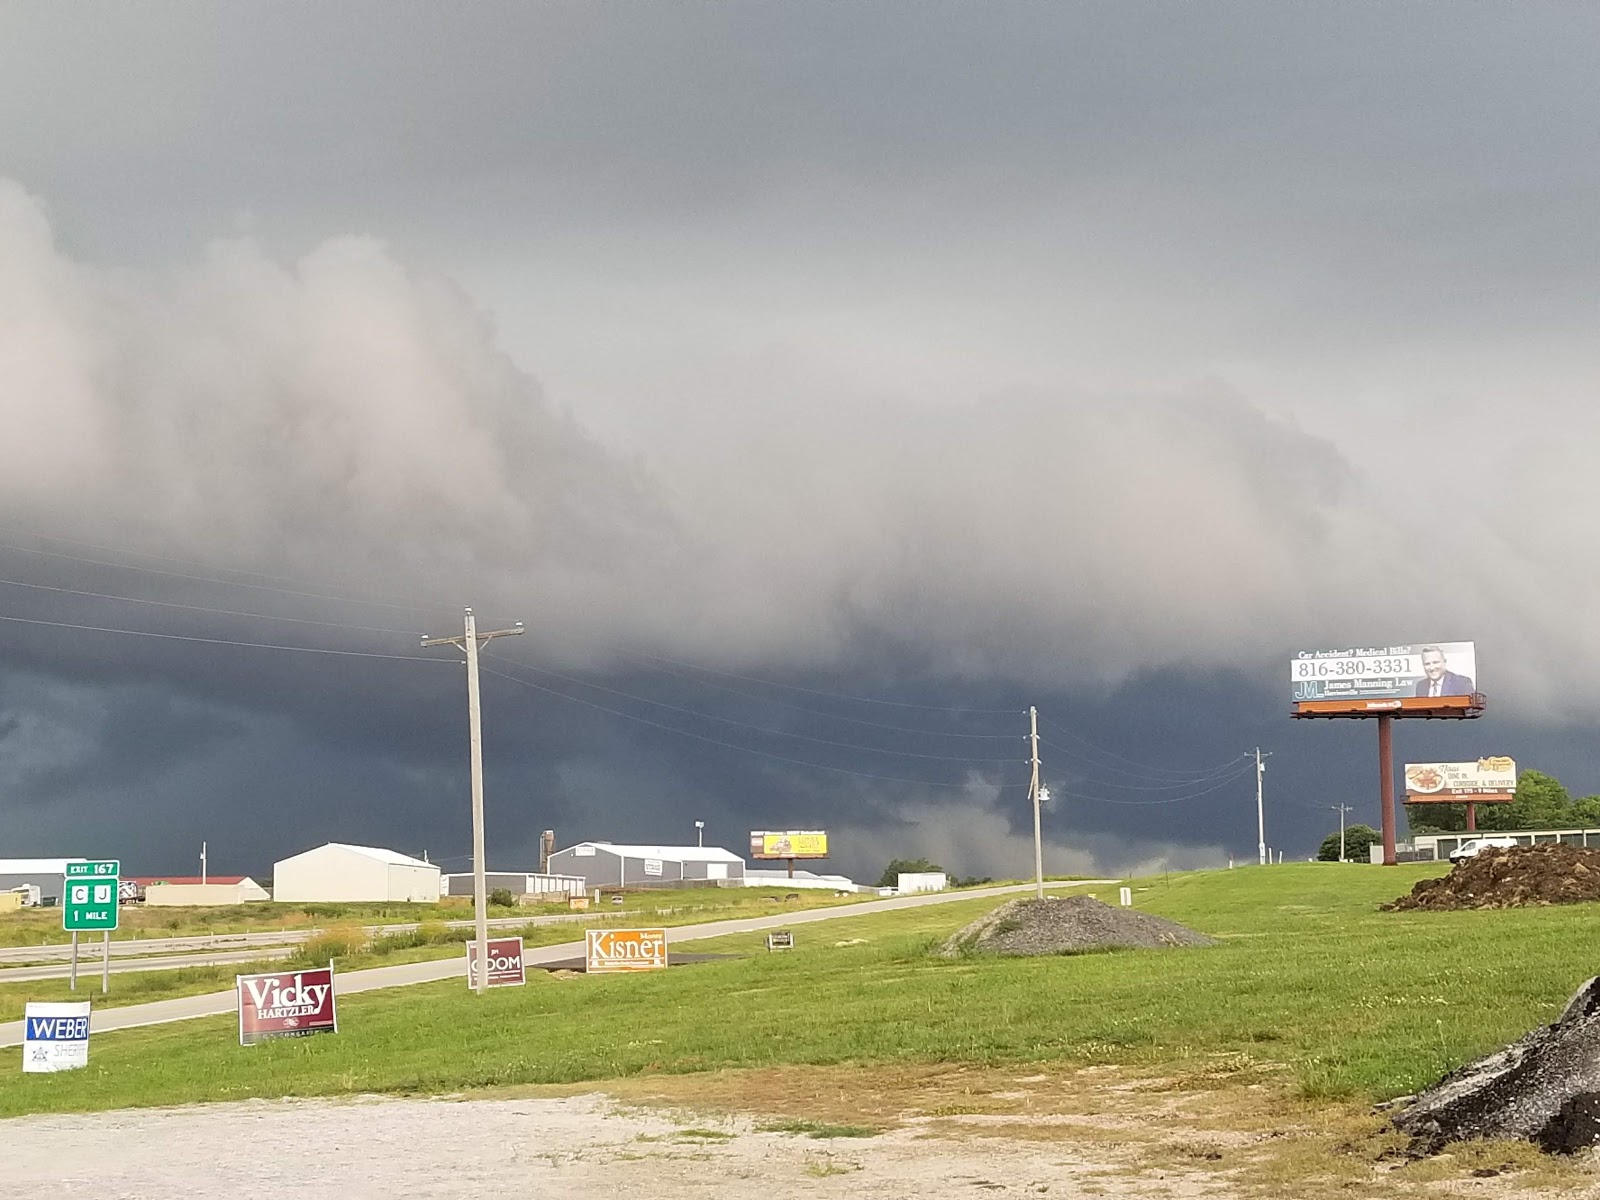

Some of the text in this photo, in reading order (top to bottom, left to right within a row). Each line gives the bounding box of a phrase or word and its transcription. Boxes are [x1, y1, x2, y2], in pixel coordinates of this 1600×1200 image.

[1298, 646, 1412, 659] Car Accident? Medical Bills?
[1298, 658, 1412, 677] 816-380-3331
[1324, 677, 1413, 690] James Manning Law
[70, 863, 114, 874] EXIT 167
[75, 887, 107, 901] C J
[73, 910, 108, 922] 1 MILE
[589, 932, 664, 959] Kisner
[242, 974, 331, 1014] Vicky
[257, 1005, 315, 1020] HARTZLER
[31, 1017, 88, 1039] WEBER
